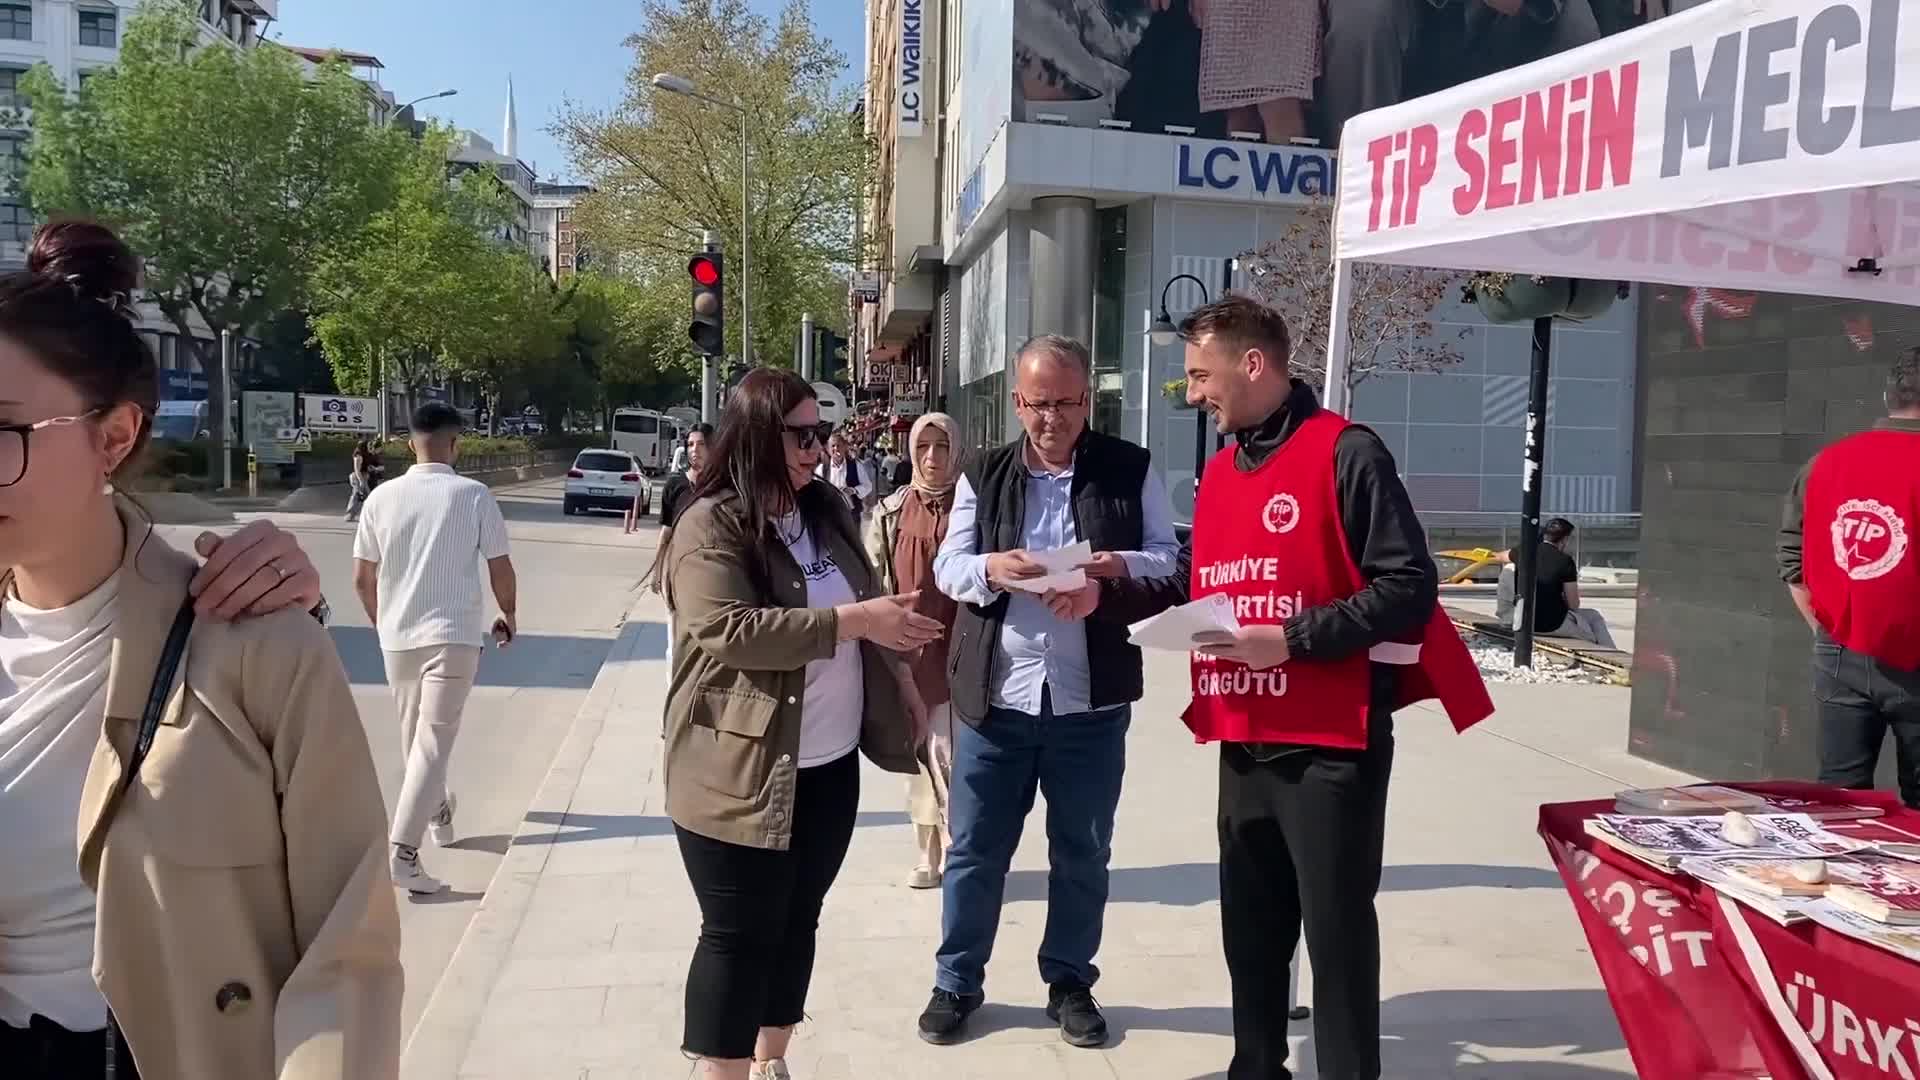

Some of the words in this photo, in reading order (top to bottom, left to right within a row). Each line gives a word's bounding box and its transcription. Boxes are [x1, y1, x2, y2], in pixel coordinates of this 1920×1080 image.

[902, 92, 919, 122] LC
[1178, 144, 1241, 189] LC
[1843, 516, 1886, 542] TİP
[1199, 553, 1279, 589] TÜRKİYE
[1230, 589, 1303, 619] RTİSİ
[1198, 666, 1288, 697] ÖRGÜTÜ
